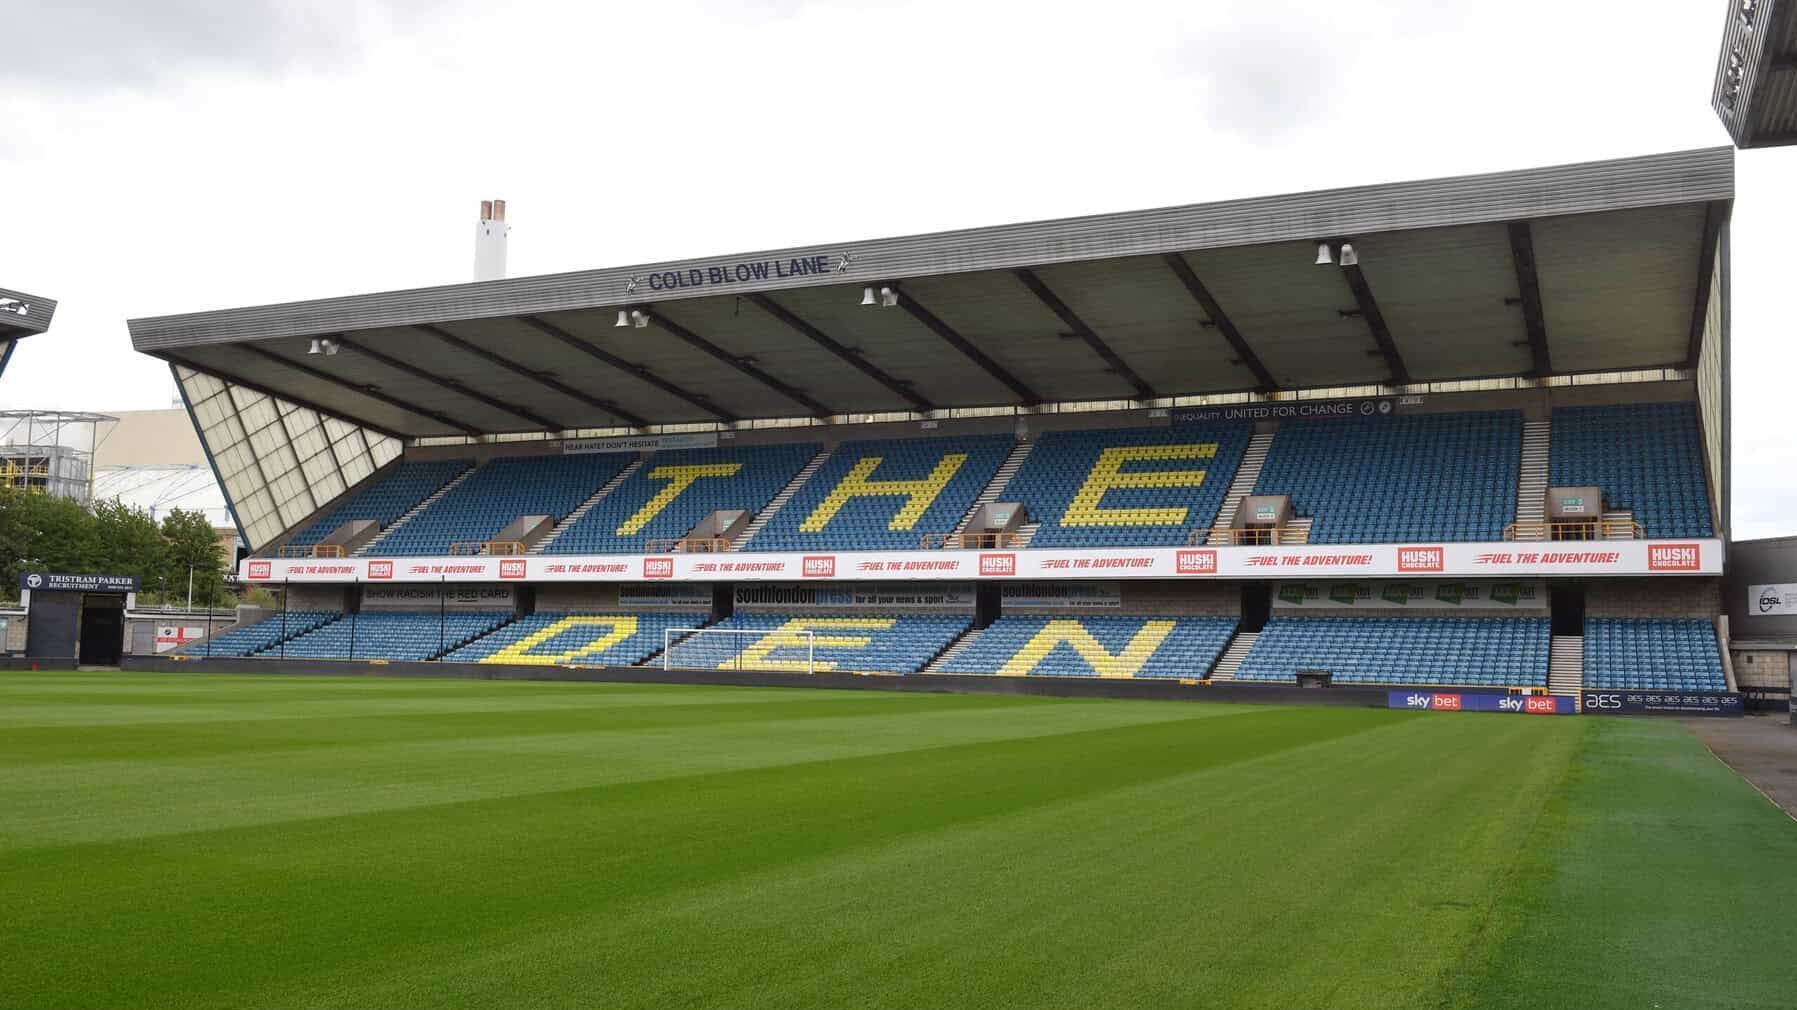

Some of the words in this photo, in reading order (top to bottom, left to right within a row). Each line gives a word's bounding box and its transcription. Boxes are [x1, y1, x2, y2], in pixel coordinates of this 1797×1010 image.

[650, 268, 703, 290] COLD
[709, 261, 769, 284] BLOW
[775, 255, 830, 278] LANE
[1224, 407, 1269, 420] UNITED
[1272, 406, 1296, 417] FOR
[1299, 403, 1353, 416] CHANGE
[615, 443, 1218, 536] THE
[1179, 553, 1214, 564] HUSKI
[1402, 550, 1440, 562] HUSKI
[1476, 554, 1512, 564] FUEL
[1516, 554, 1539, 563] THE
[1540, 552, 1620, 564] ADVENTURE!
[1652, 548, 1695, 560] HUSKI
[805, 559, 833, 569] HUSKI
[860, 562, 885, 570] FUEL
[887, 562, 902, 570] THE
[903, 560, 960, 570] ADVENTURE!
[982, 557, 1012, 567] HUSKI
[1043, 559, 1071, 568] FUEL
[1073, 559, 1090, 568] THE
[1091, 558, 1155, 568] ADVENTURE!
[1248, 556, 1278, 566] FUEL
[1281, 556, 1300, 565] THE
[1302, 555, 1373, 565] ADVENTURE!
[568, 565, 582, 573] THE
[696, 563, 717, 572] FUEL
[720, 563, 734, 572] THE
[735, 562, 785, 571] ADVENTURE!
[49, 575, 96, 584] TRISTRAM
[98, 576, 133, 585] PARKER
[480, 589, 509, 598] CARD
[479, 616, 1176, 679] DEN
[1407, 693, 1431, 709] sky
[1434, 695, 1458, 707] bet
[1499, 696, 1523, 711] sky
[1528, 698, 1553, 710] bet
